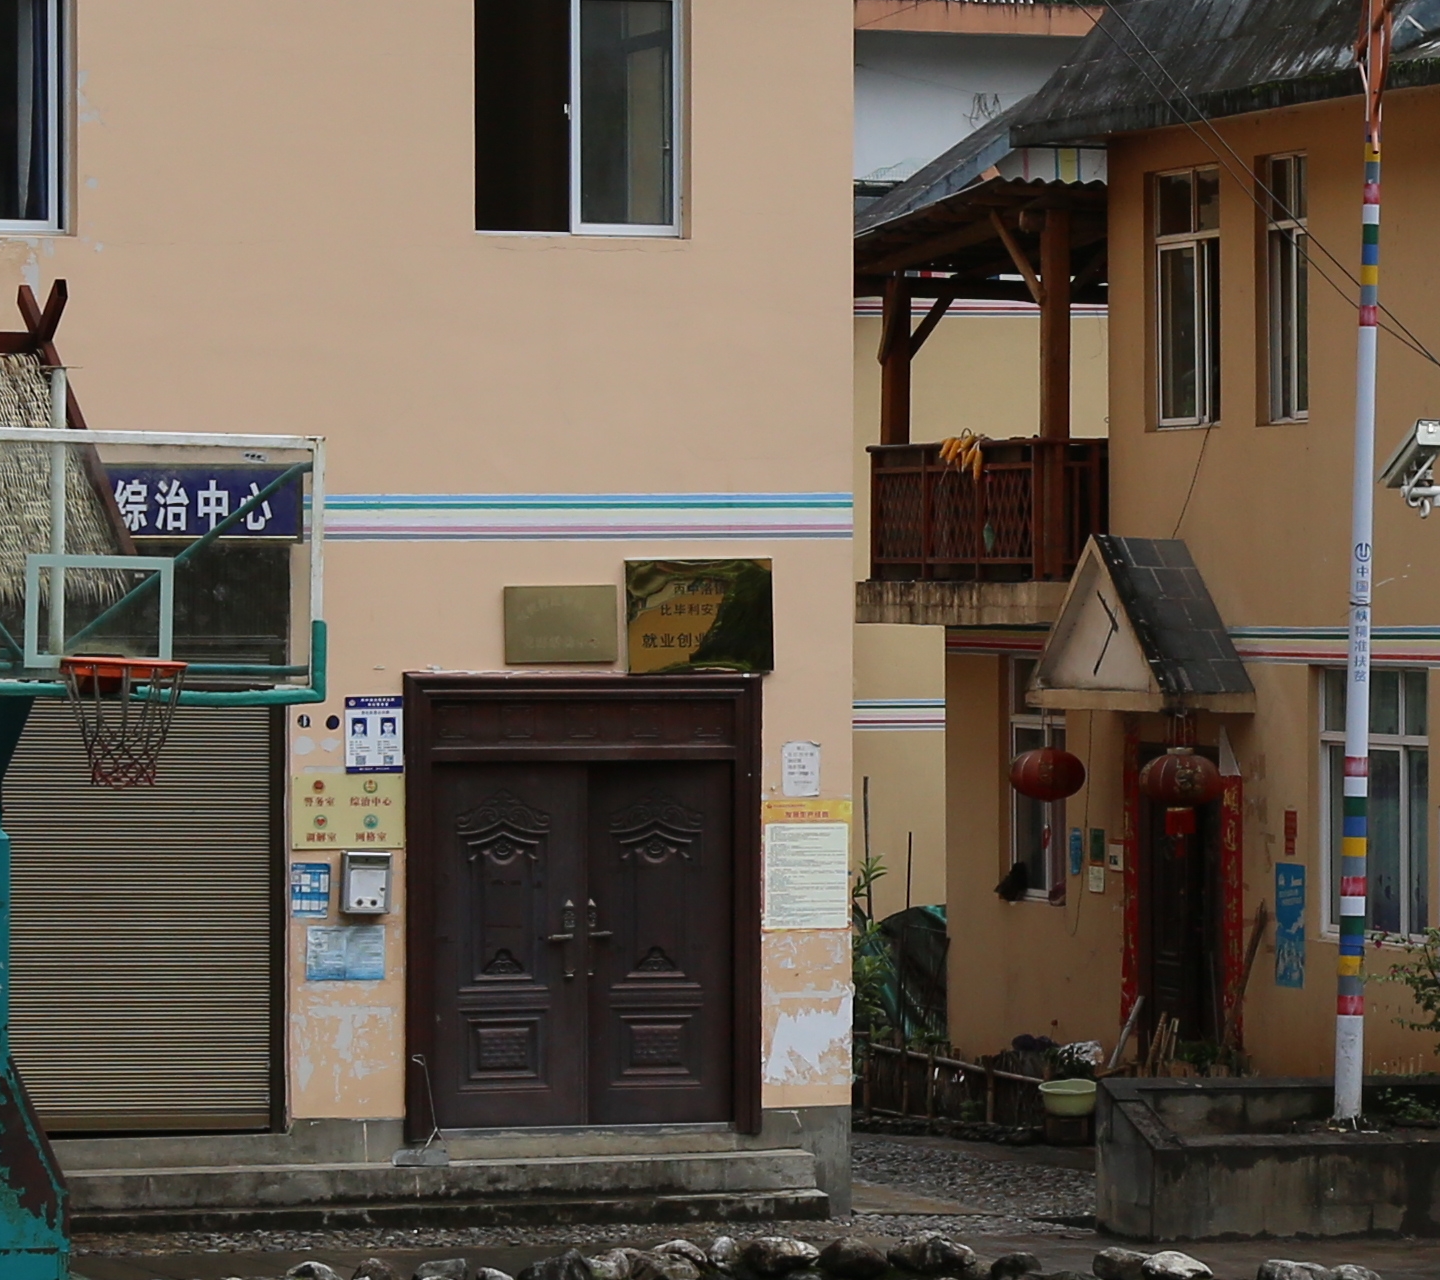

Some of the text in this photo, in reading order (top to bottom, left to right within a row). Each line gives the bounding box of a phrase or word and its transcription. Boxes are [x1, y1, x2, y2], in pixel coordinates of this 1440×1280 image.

[114, 479, 273, 531] 综治中心
[660, 603, 719, 616] 比毕利安
[350, 796, 392, 807] 综治中心
